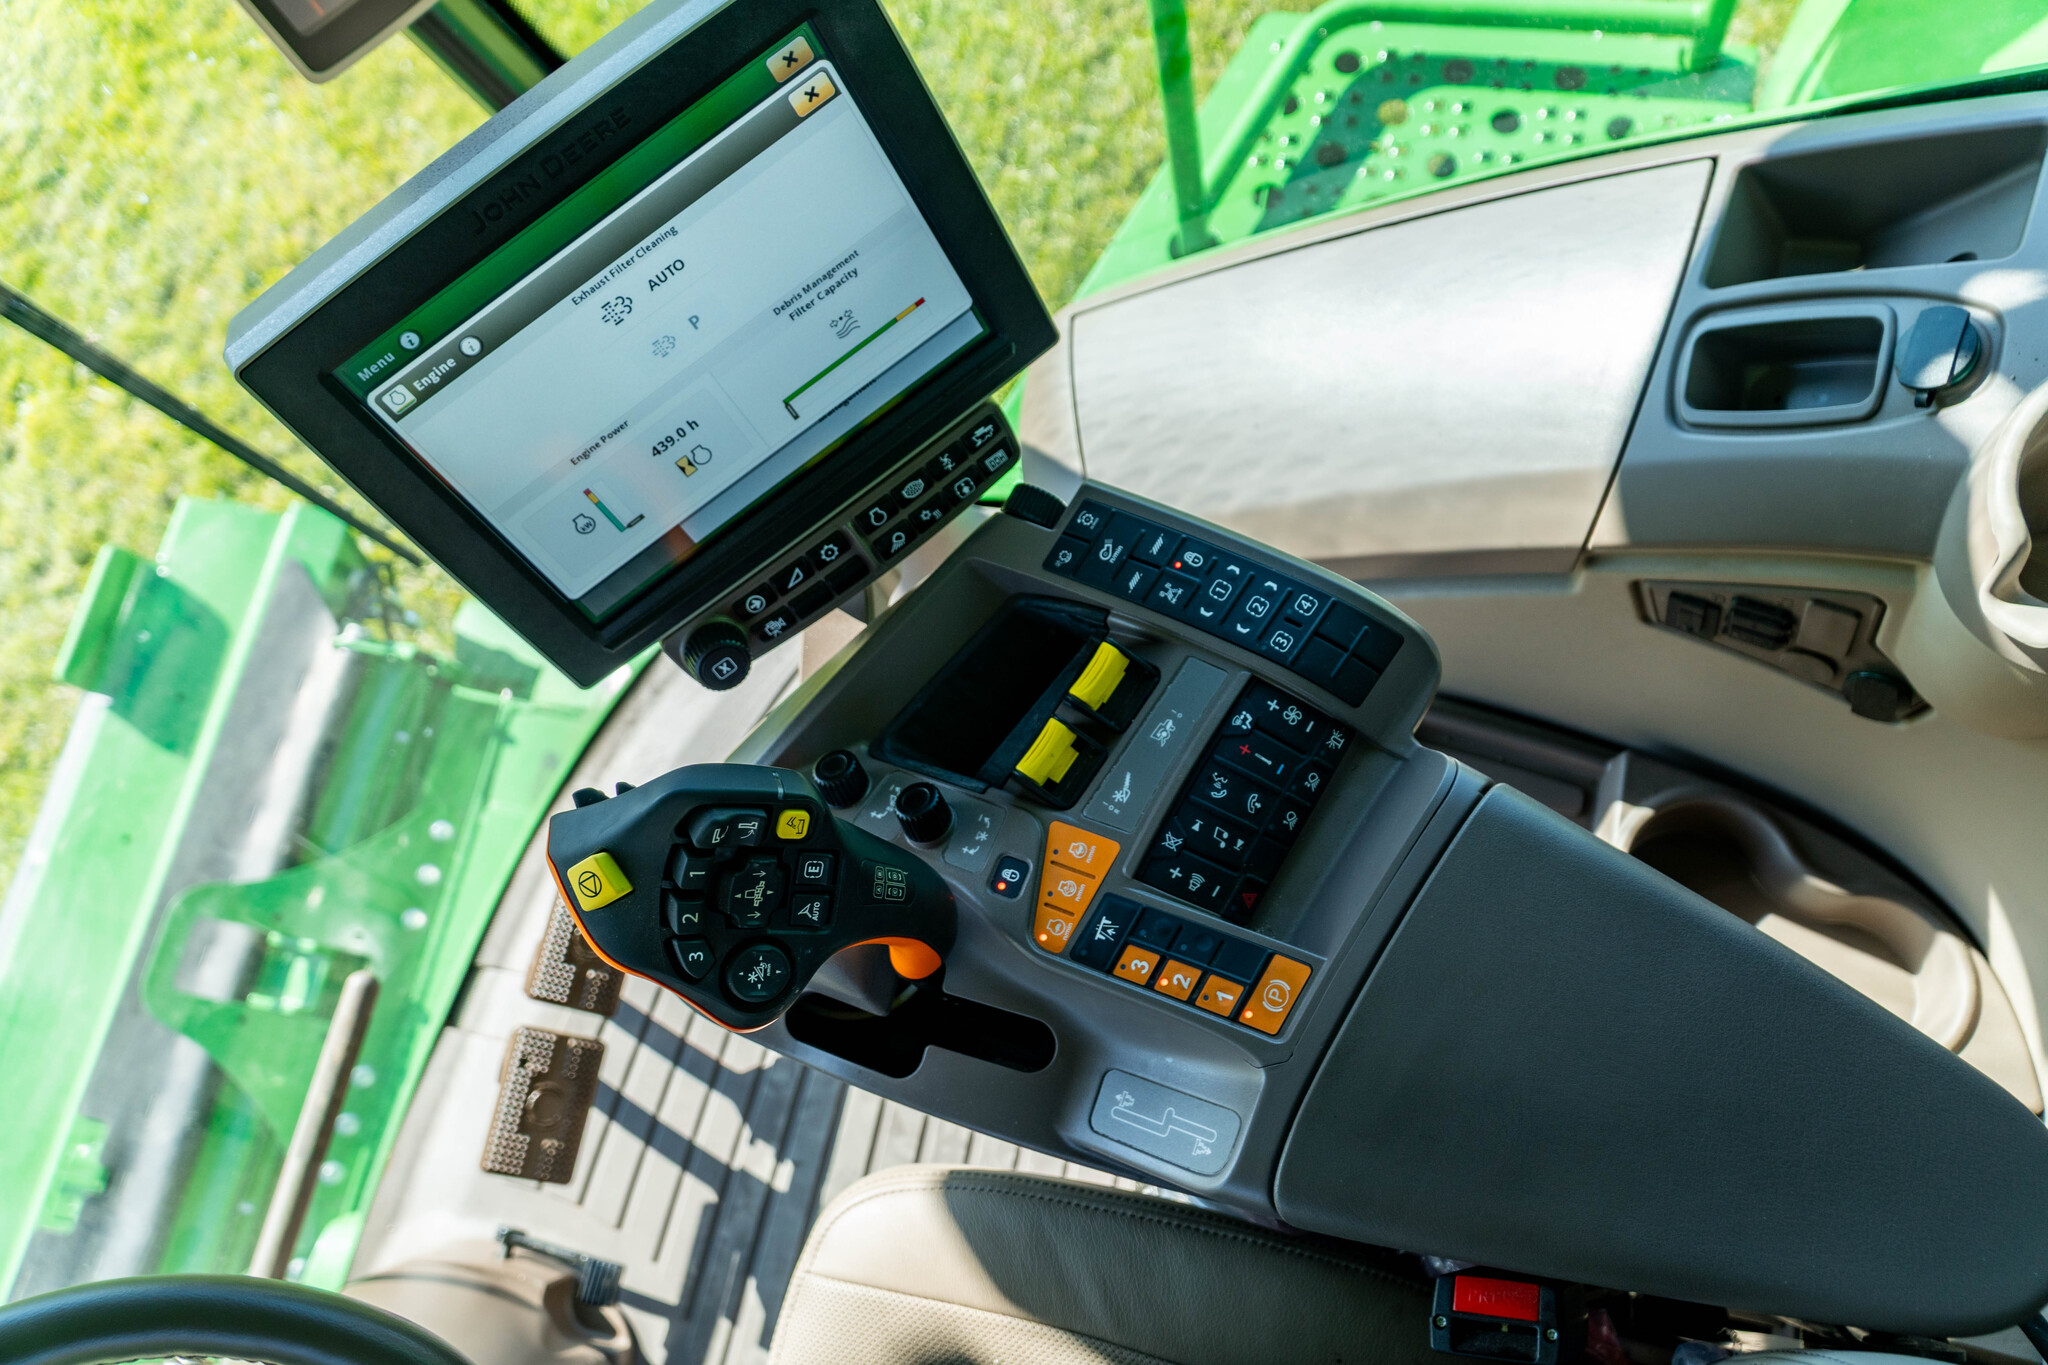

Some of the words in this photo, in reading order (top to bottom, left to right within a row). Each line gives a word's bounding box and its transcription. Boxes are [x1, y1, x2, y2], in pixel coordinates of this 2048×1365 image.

[471, 174, 542, 235] JOHN
[541, 106, 632, 178] DEERE
[571, 275, 610, 306] Exhaust
[608, 256, 635, 278] Filter
[635, 226, 679, 258] Cleaning
[648, 259, 685, 291] AUTO
[772, 292, 802, 316] Debris
[801, 250, 860, 294] Management
[788, 298, 815, 321] Filter
[816, 267, 858, 301] Capacity
[688, 315, 700, 330] P
[356, 352, 396, 381] Menu
[412, 358, 457, 392] Engine
[570, 442, 602, 466] Engine
[599, 420, 629, 444] Power
[652, 426, 687, 457] 439.0
[686, 418, 699, 431] h
[1252, 602, 1264, 612] 2
[1301, 600, 1312, 610] 4
[1276, 636, 1288, 647] 3
[682, 912, 699, 924] 2
[812, 901, 821, 921] AUTO
[688, 952, 704, 962] 3
[1130, 959, 1149, 974] 3
[1172, 973, 1192, 990] 2
[1216, 990, 1234, 1001] 1
[1268, 987, 1283, 1003] P
